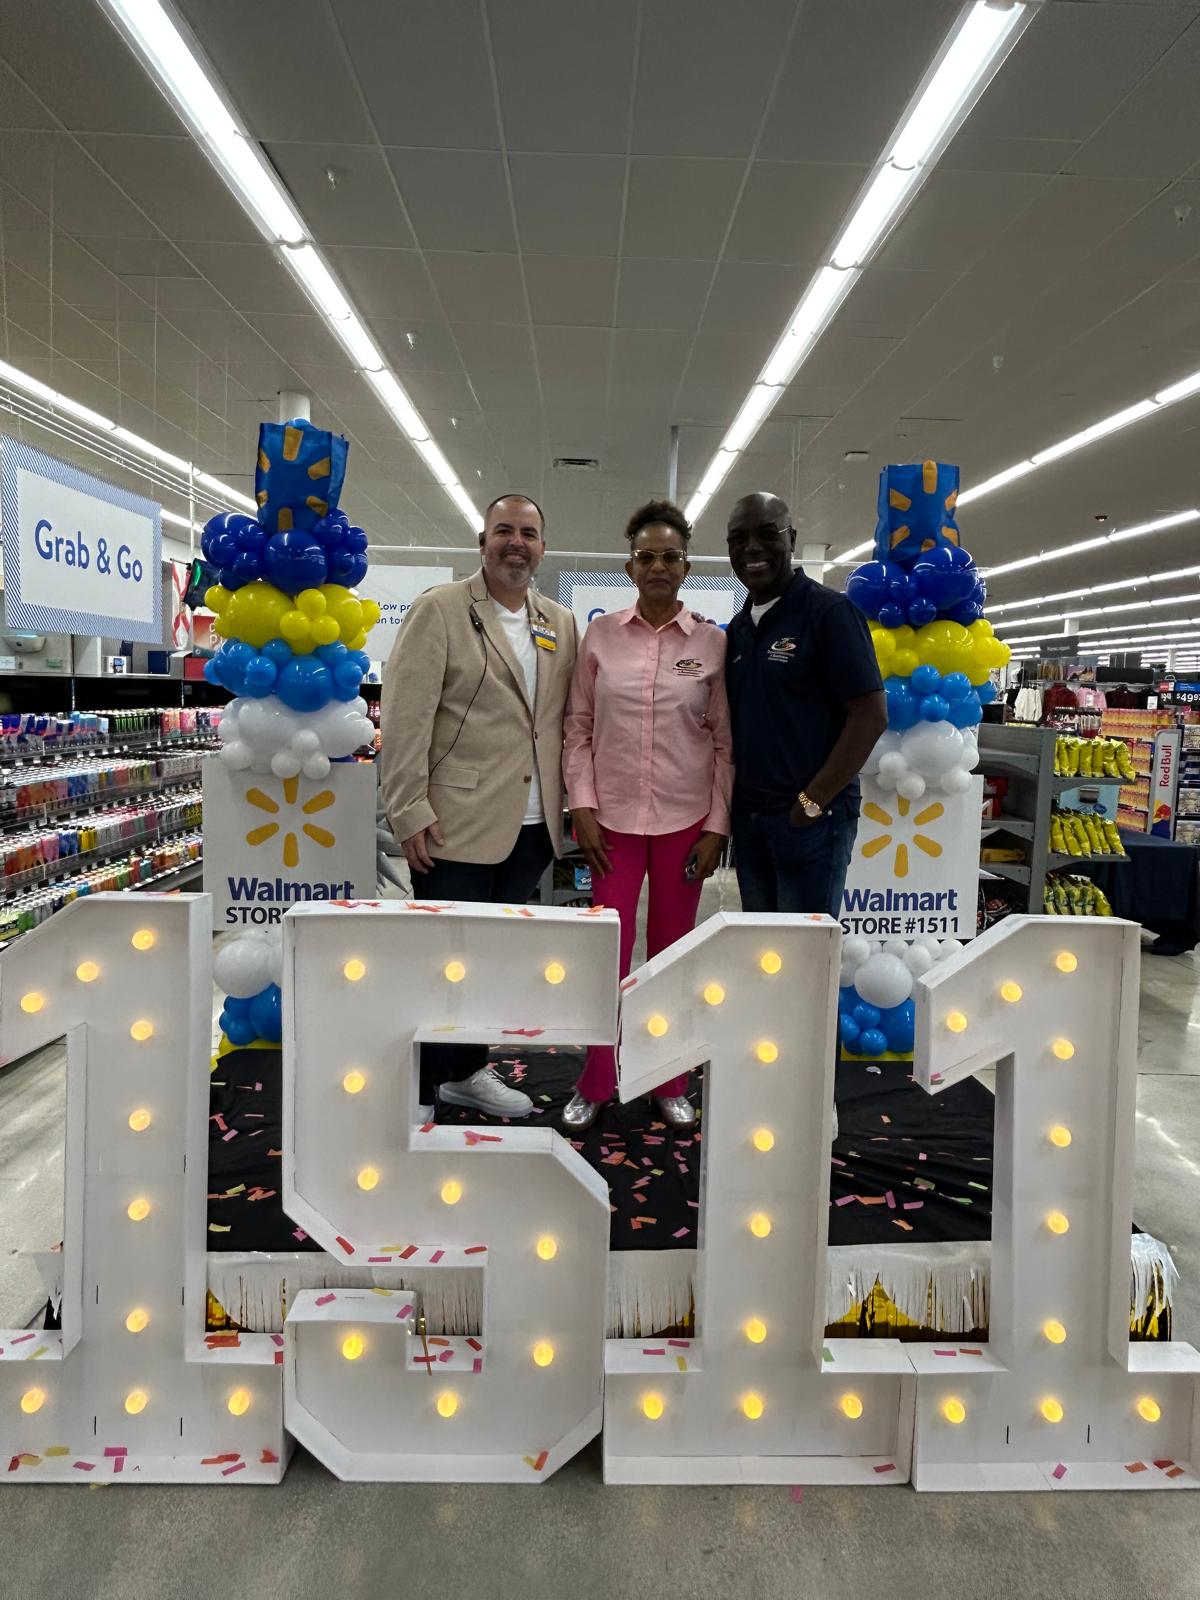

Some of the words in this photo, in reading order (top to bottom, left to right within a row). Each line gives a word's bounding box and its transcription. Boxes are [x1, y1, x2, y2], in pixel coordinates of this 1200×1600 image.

[34, 519, 90, 570] Grab
[97, 537, 111, 575] &
[117, 544, 143, 582] Go
[227, 876, 355, 902] Walmart
[843, 888, 958, 912] Walmart
[840, 917, 902, 935] STORE
[904, 916, 959, 934] #1511
